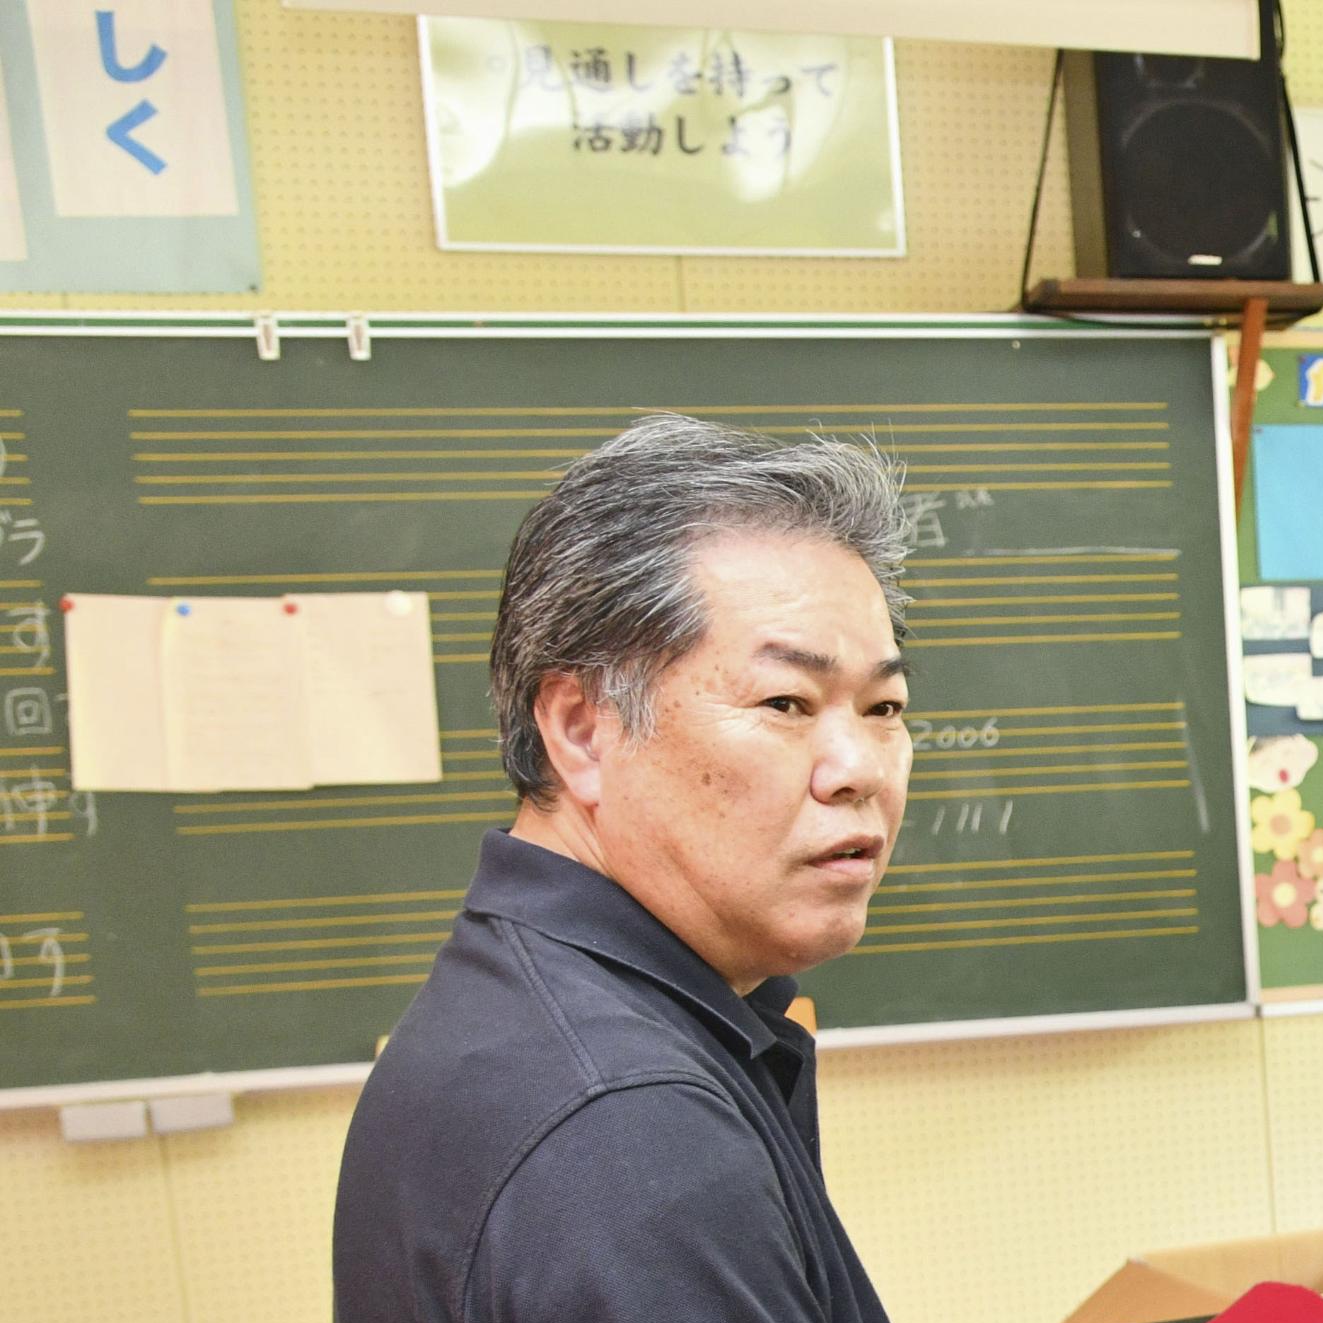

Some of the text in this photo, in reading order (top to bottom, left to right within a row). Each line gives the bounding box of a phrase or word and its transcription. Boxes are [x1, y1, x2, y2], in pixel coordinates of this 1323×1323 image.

[571, 112, 793, 156] 活動しよう
[909, 717, 1000, 750] 2006
